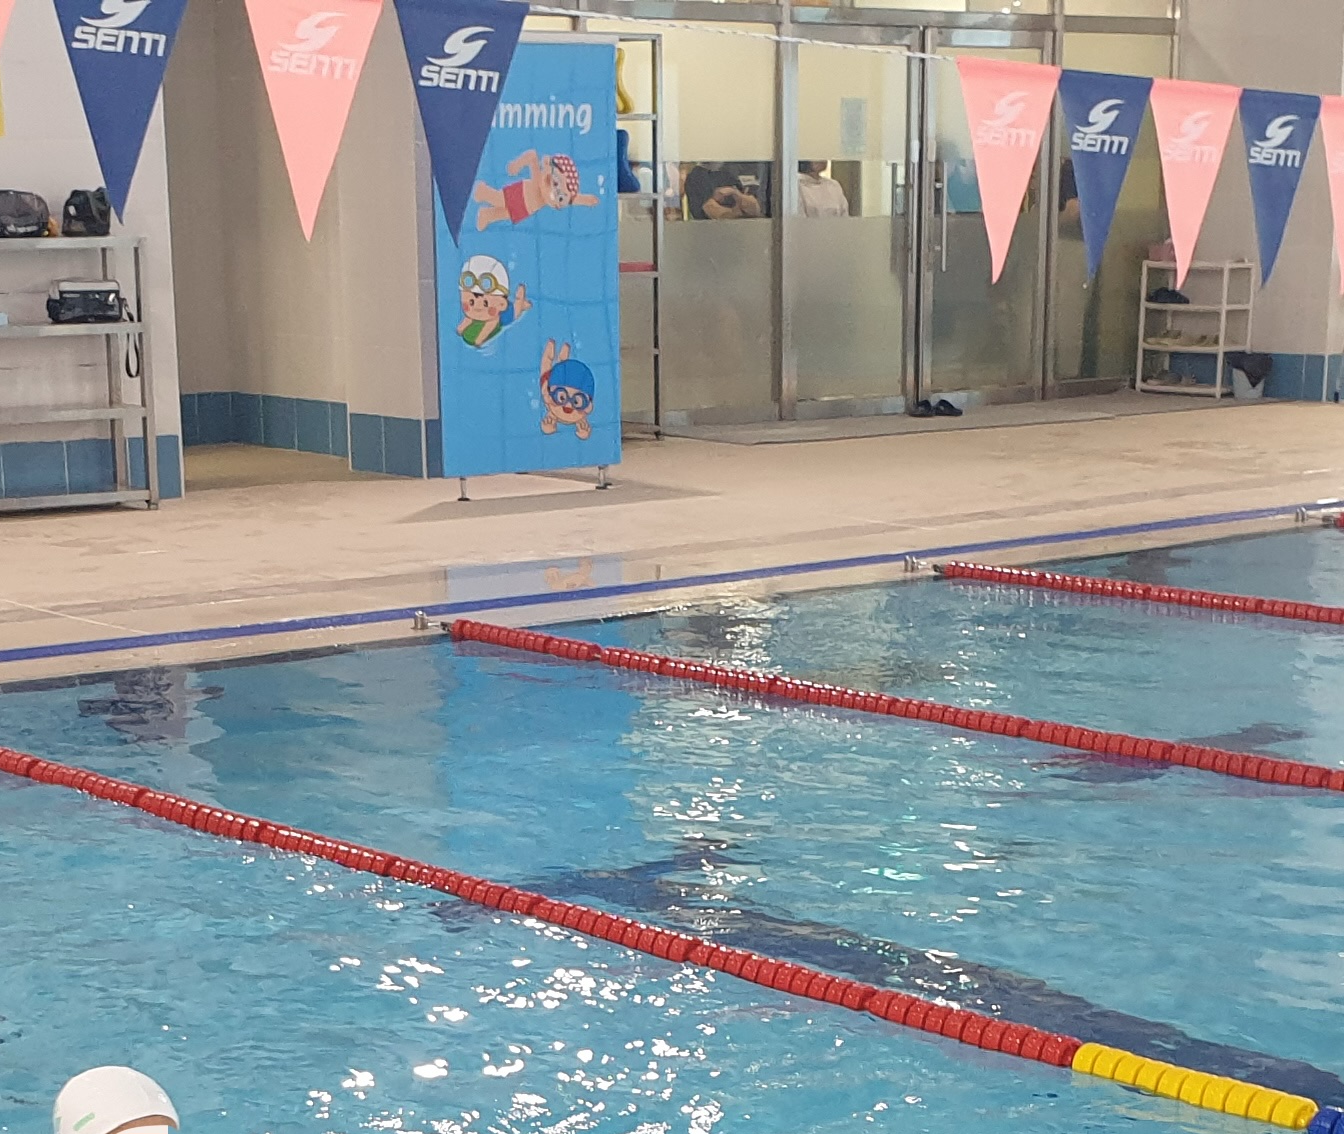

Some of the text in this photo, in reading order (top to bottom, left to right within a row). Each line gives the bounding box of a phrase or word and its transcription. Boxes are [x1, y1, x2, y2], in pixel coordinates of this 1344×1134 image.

[71, 25, 166, 57] SENTI
[267, 50, 355, 81] SENTI
[418, 65, 500, 93] SENTI
[492, 95, 592, 135] mming
[974, 124, 1036, 148] SENTI
[1071, 133, 1128, 155] SENTI
[1248, 146, 1302, 168] SENTI
